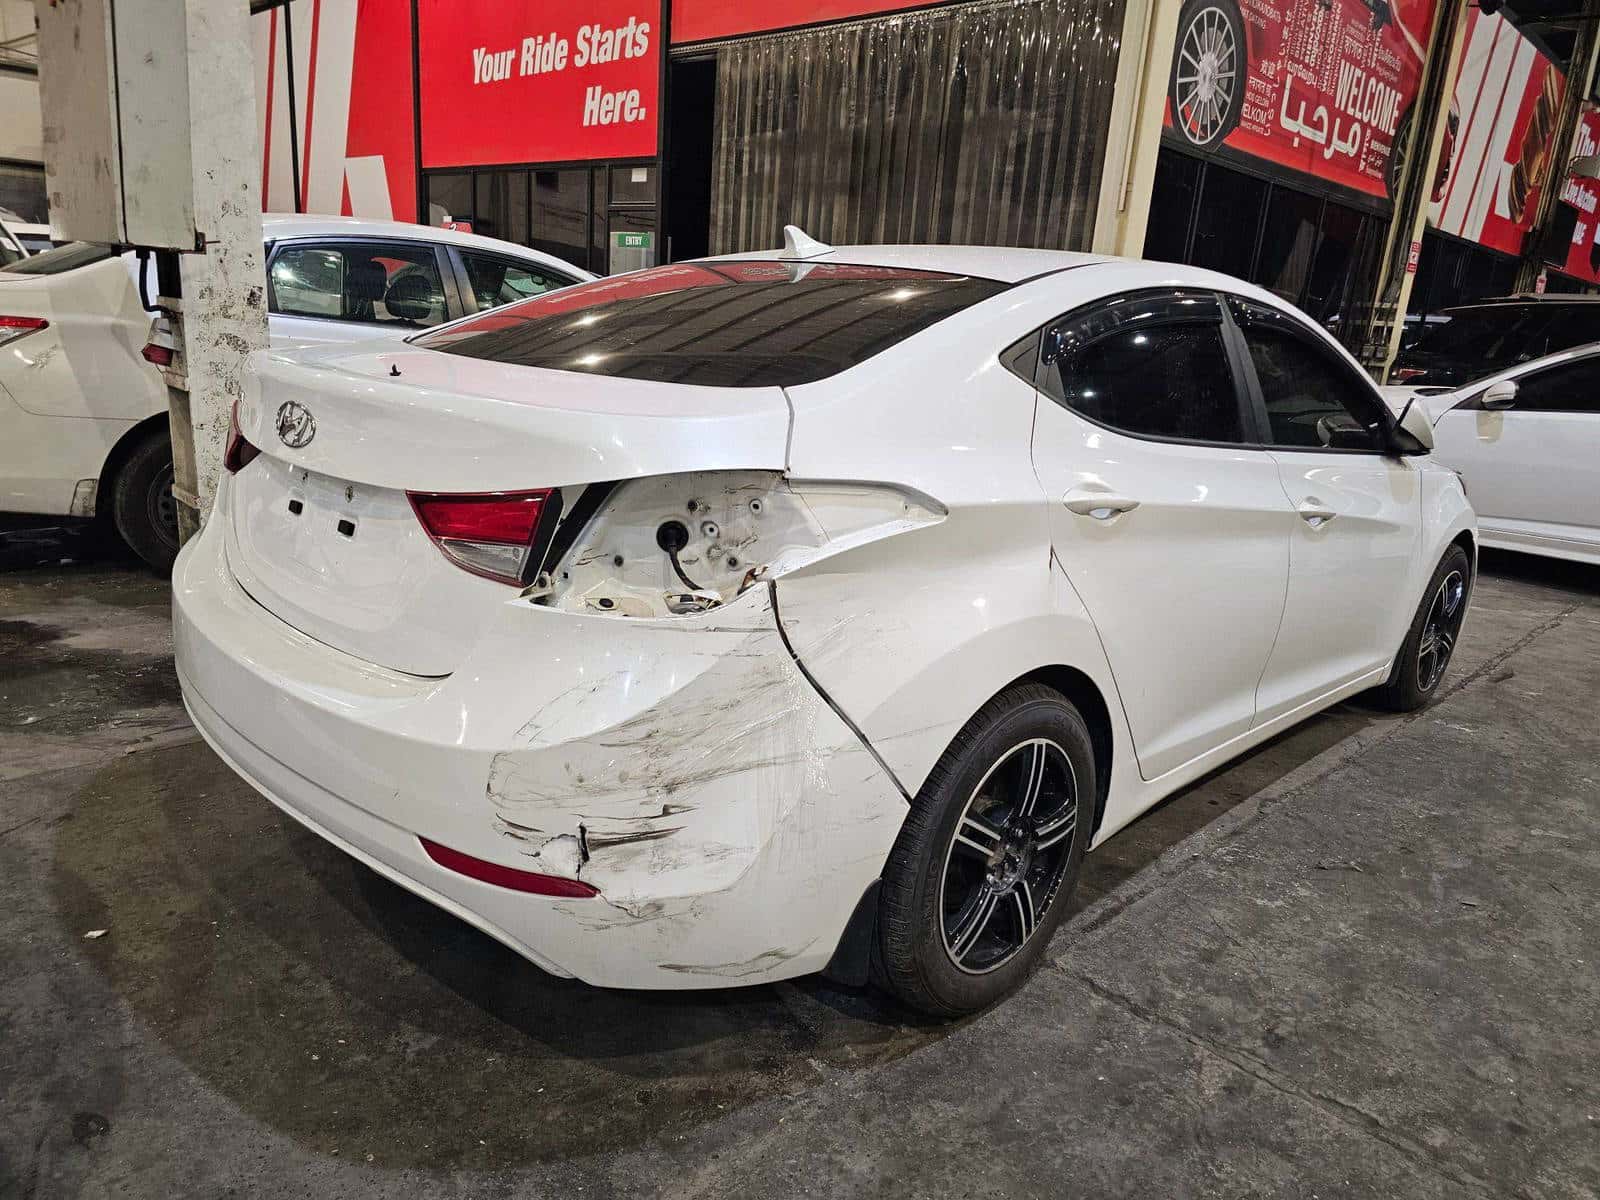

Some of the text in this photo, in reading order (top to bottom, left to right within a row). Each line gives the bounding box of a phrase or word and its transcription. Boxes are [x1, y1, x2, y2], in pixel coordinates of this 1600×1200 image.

[473, 16, 651, 85] Your Ride Starts
[1321, 4, 1342, 92] WILLKOMMEN
[583, 86, 645, 128] Here.
[1280, 72, 1361, 160] مرحبا
[1335, 59, 1404, 137] WELCOME
[625, 236, 643, 246] ENTRY
